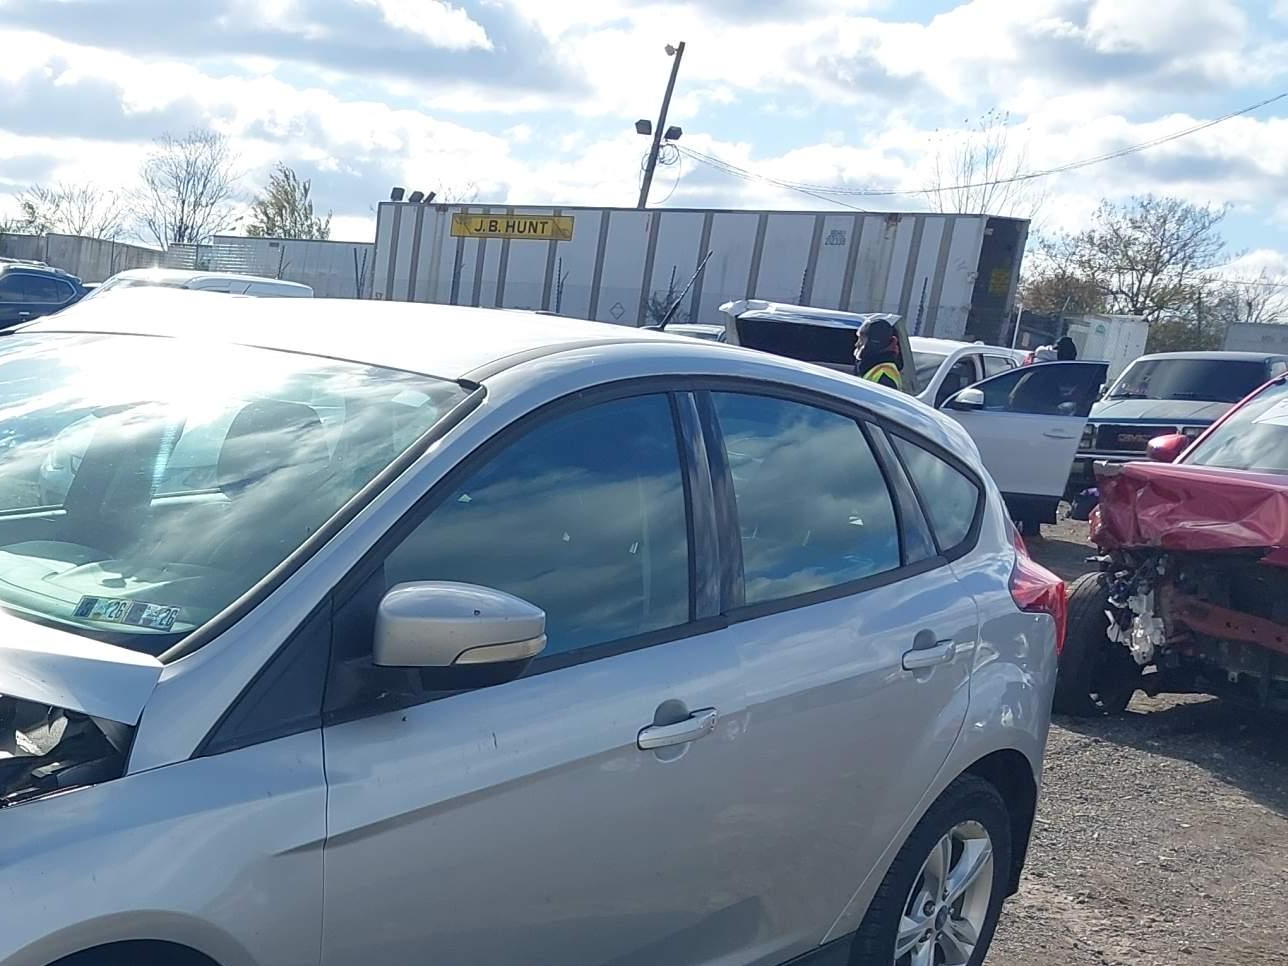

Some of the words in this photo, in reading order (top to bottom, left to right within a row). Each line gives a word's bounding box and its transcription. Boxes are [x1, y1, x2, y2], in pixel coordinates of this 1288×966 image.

[505, 221, 549, 234] HUNT
[108, 601, 127, 619] 26
[159, 608, 178, 626] 26
